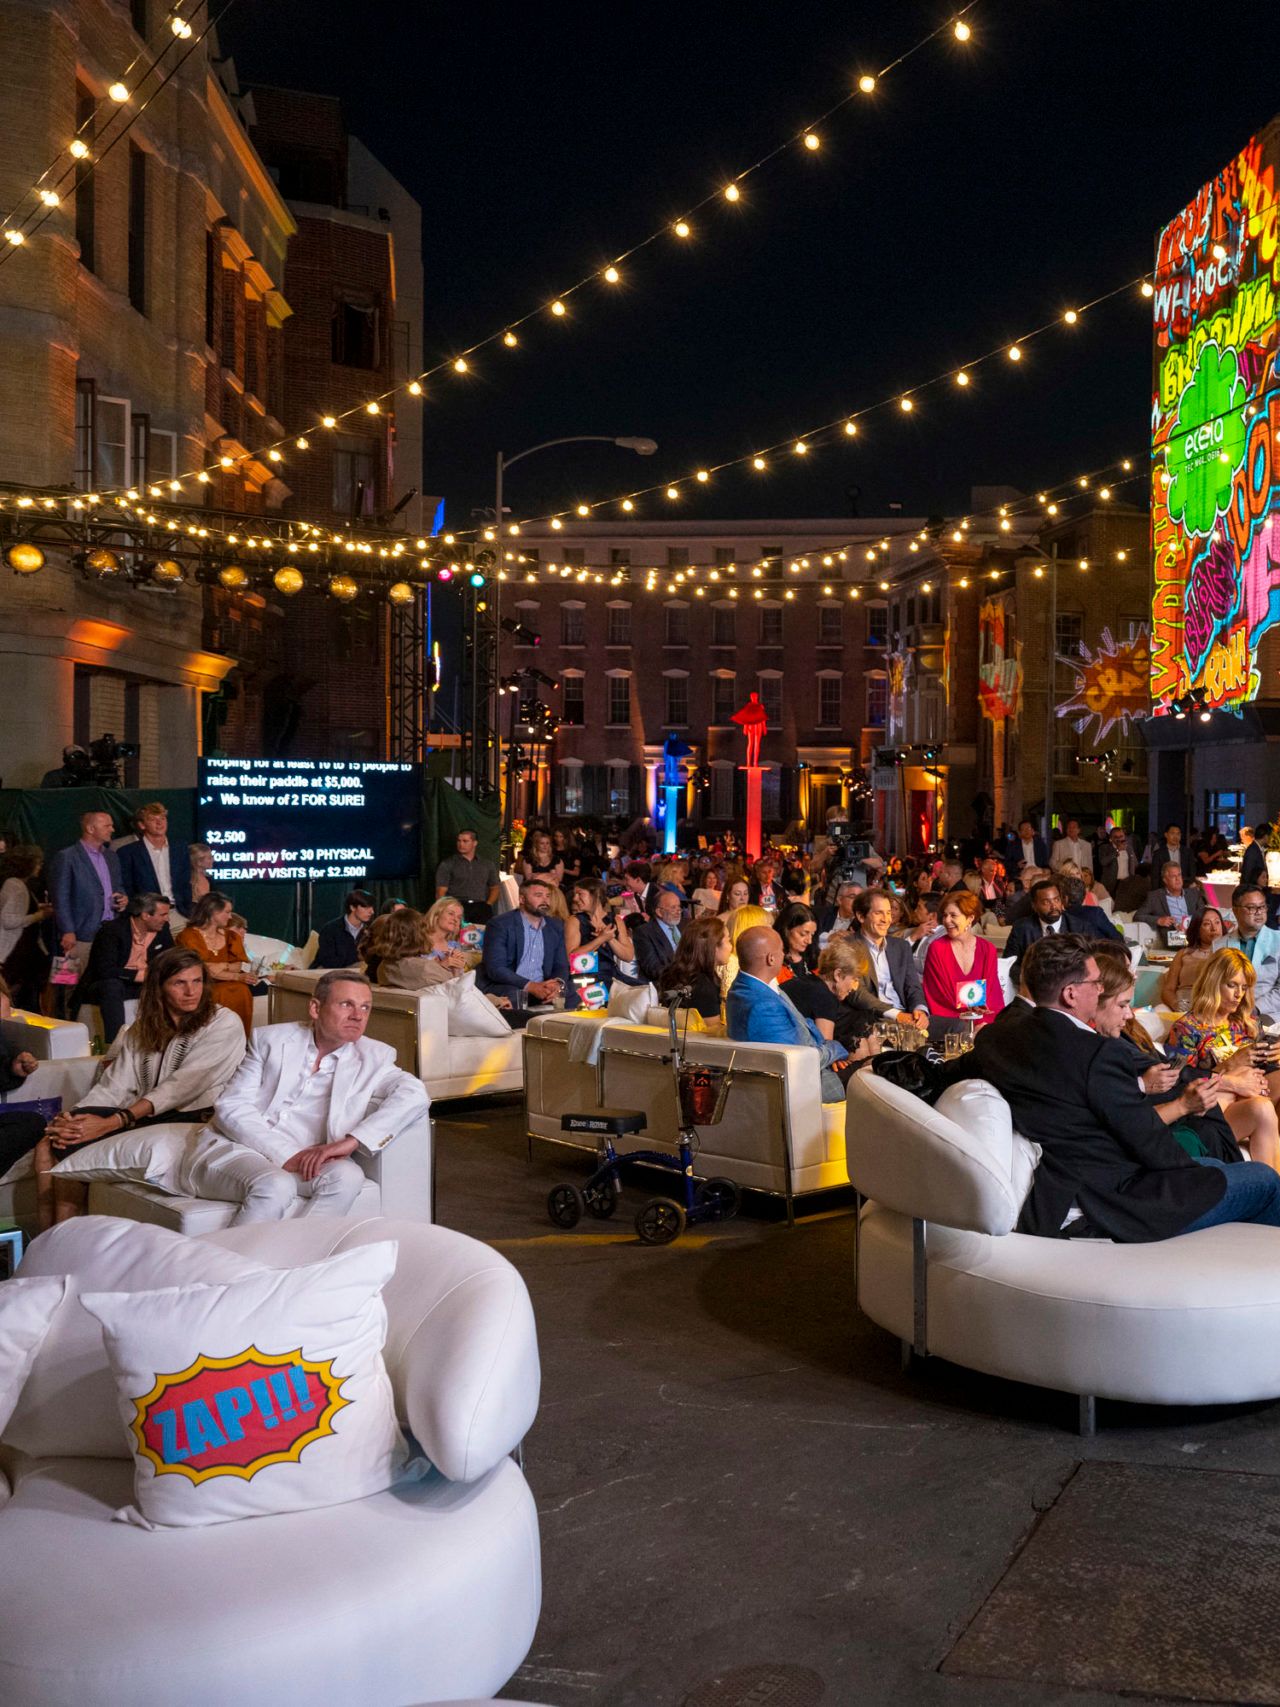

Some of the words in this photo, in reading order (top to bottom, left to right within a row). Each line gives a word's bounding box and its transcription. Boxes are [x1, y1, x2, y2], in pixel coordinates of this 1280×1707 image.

[207, 774, 238, 786] raise
[240, 774, 268, 786] their
[269, 775, 309, 789] paddle
[311, 777, 323, 787] at
[324, 775, 363, 789] $5,000.
[220, 793, 240, 805] We
[242, 793, 275, 805] know
[277, 794, 290, 806] of
[291, 794, 300, 806] 2
[302, 794, 327, 806] FOR
[329, 794, 365, 806] SURE!
[206, 830, 246, 844] $2,500
[232, 852, 254, 862] can
[256, 851, 280, 864] pay
[281, 849, 298, 861] for
[300, 848, 314, 860] 30
[316, 848, 374, 860] PHYSICAL
[268, 866, 307, 879] VISITS
[309, 866, 326, 878] for
[467, 933, 477, 942] 12
[581, 958, 588, 968] 9
[967, 987, 975, 1000] 6
[153, 1365, 316, 1464] ZAP!!!
